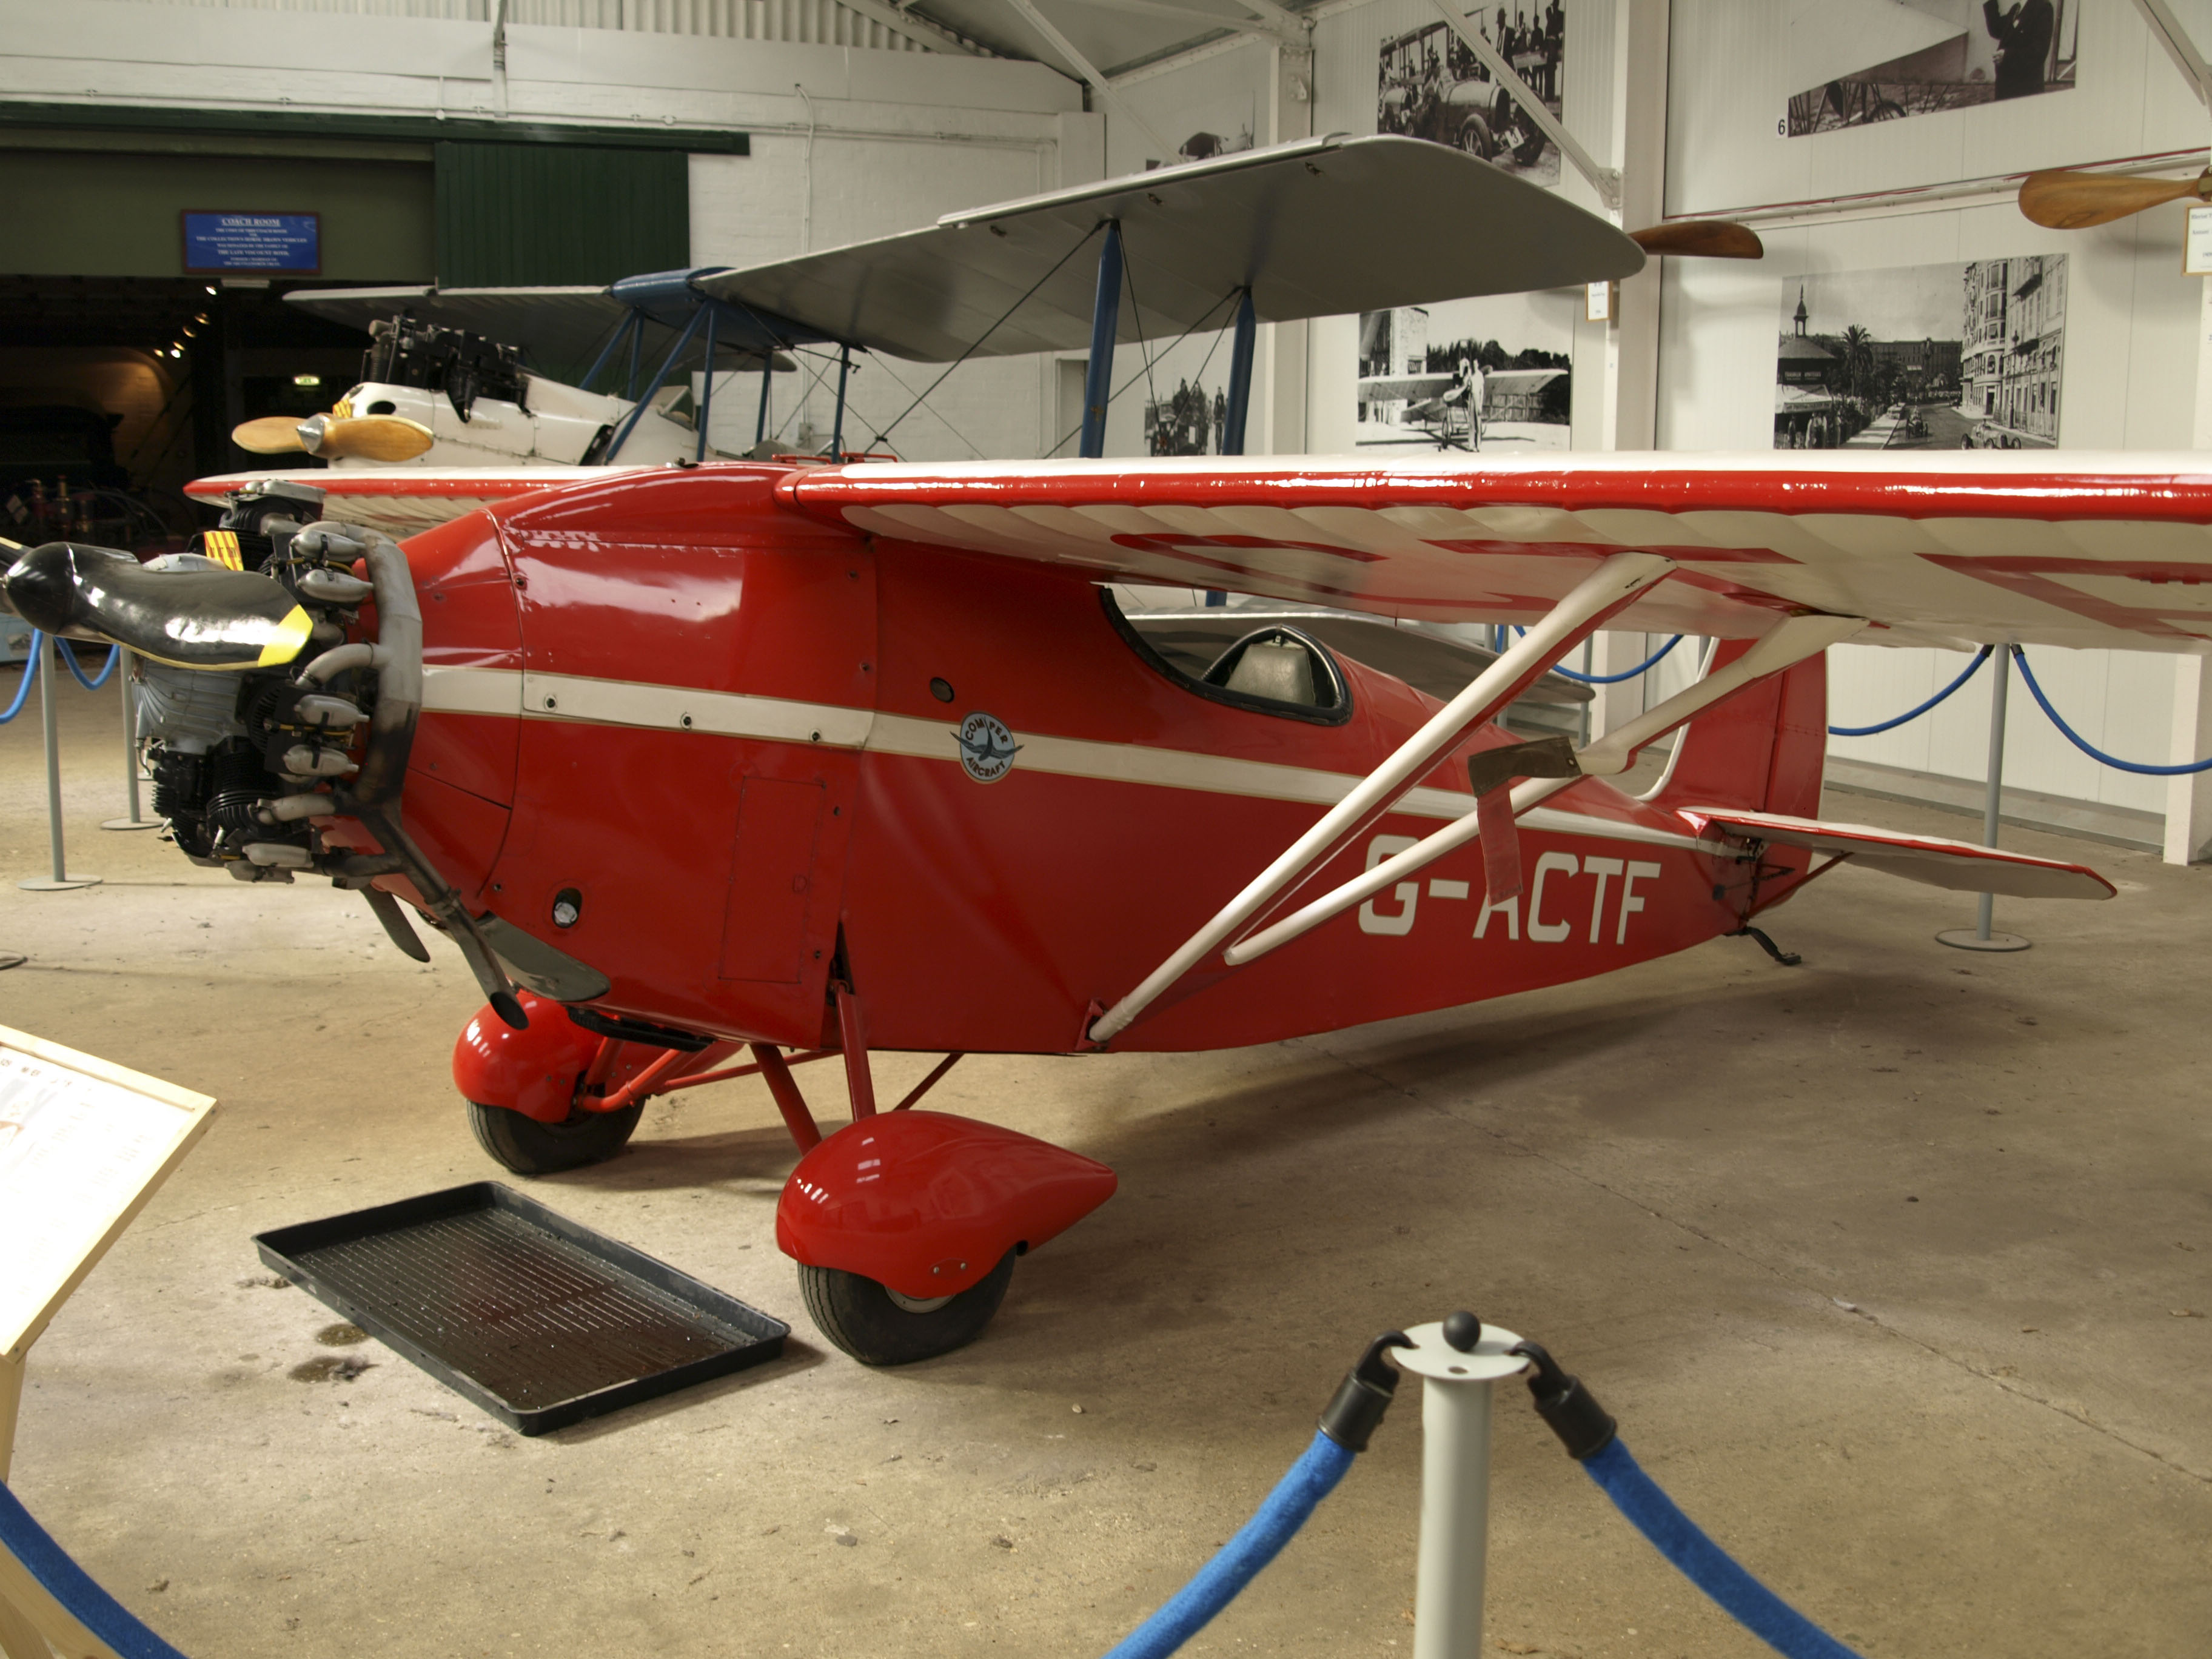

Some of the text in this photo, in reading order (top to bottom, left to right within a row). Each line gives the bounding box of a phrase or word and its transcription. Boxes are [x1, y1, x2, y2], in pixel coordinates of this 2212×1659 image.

[1778, 119, 1786, 135] 6
[253, 218, 280, 227] ROOM
[965, 718, 1008, 745] COMPER
[966, 757, 1005, 777] AIRCRAFT
[1358, 834, 1662, 945] G-ACTF
